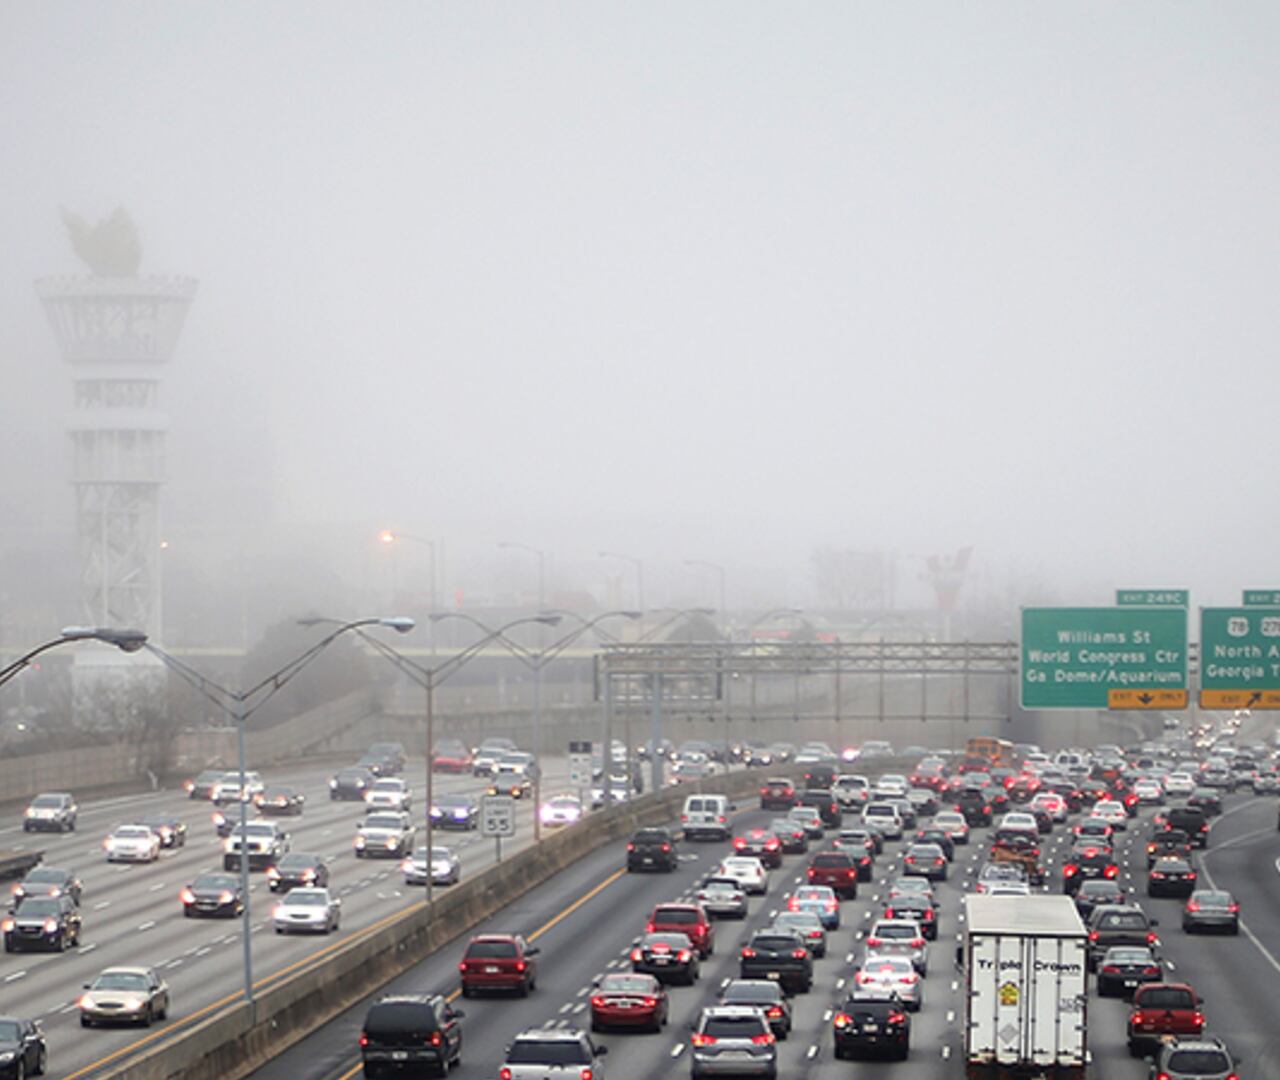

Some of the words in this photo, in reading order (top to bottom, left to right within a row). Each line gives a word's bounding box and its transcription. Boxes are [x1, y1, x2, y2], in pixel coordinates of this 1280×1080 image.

[1231, 620, 1246, 633] 78
[1057, 630, 1126, 644] Williams
[1132, 630, 1151, 644] St
[1028, 650, 1070, 663] World
[1078, 649, 1146, 666] Congress
[1155, 649, 1179, 663] Ctr
[1215, 645, 1262, 658] North
[1026, 669, 1046, 683] Ga
[1054, 669, 1183, 685] Dome/Aquarium
[1207, 664, 1264, 682] Georgia
[487, 818, 509, 831] 55
[1033, 960, 1081, 972] Crown
